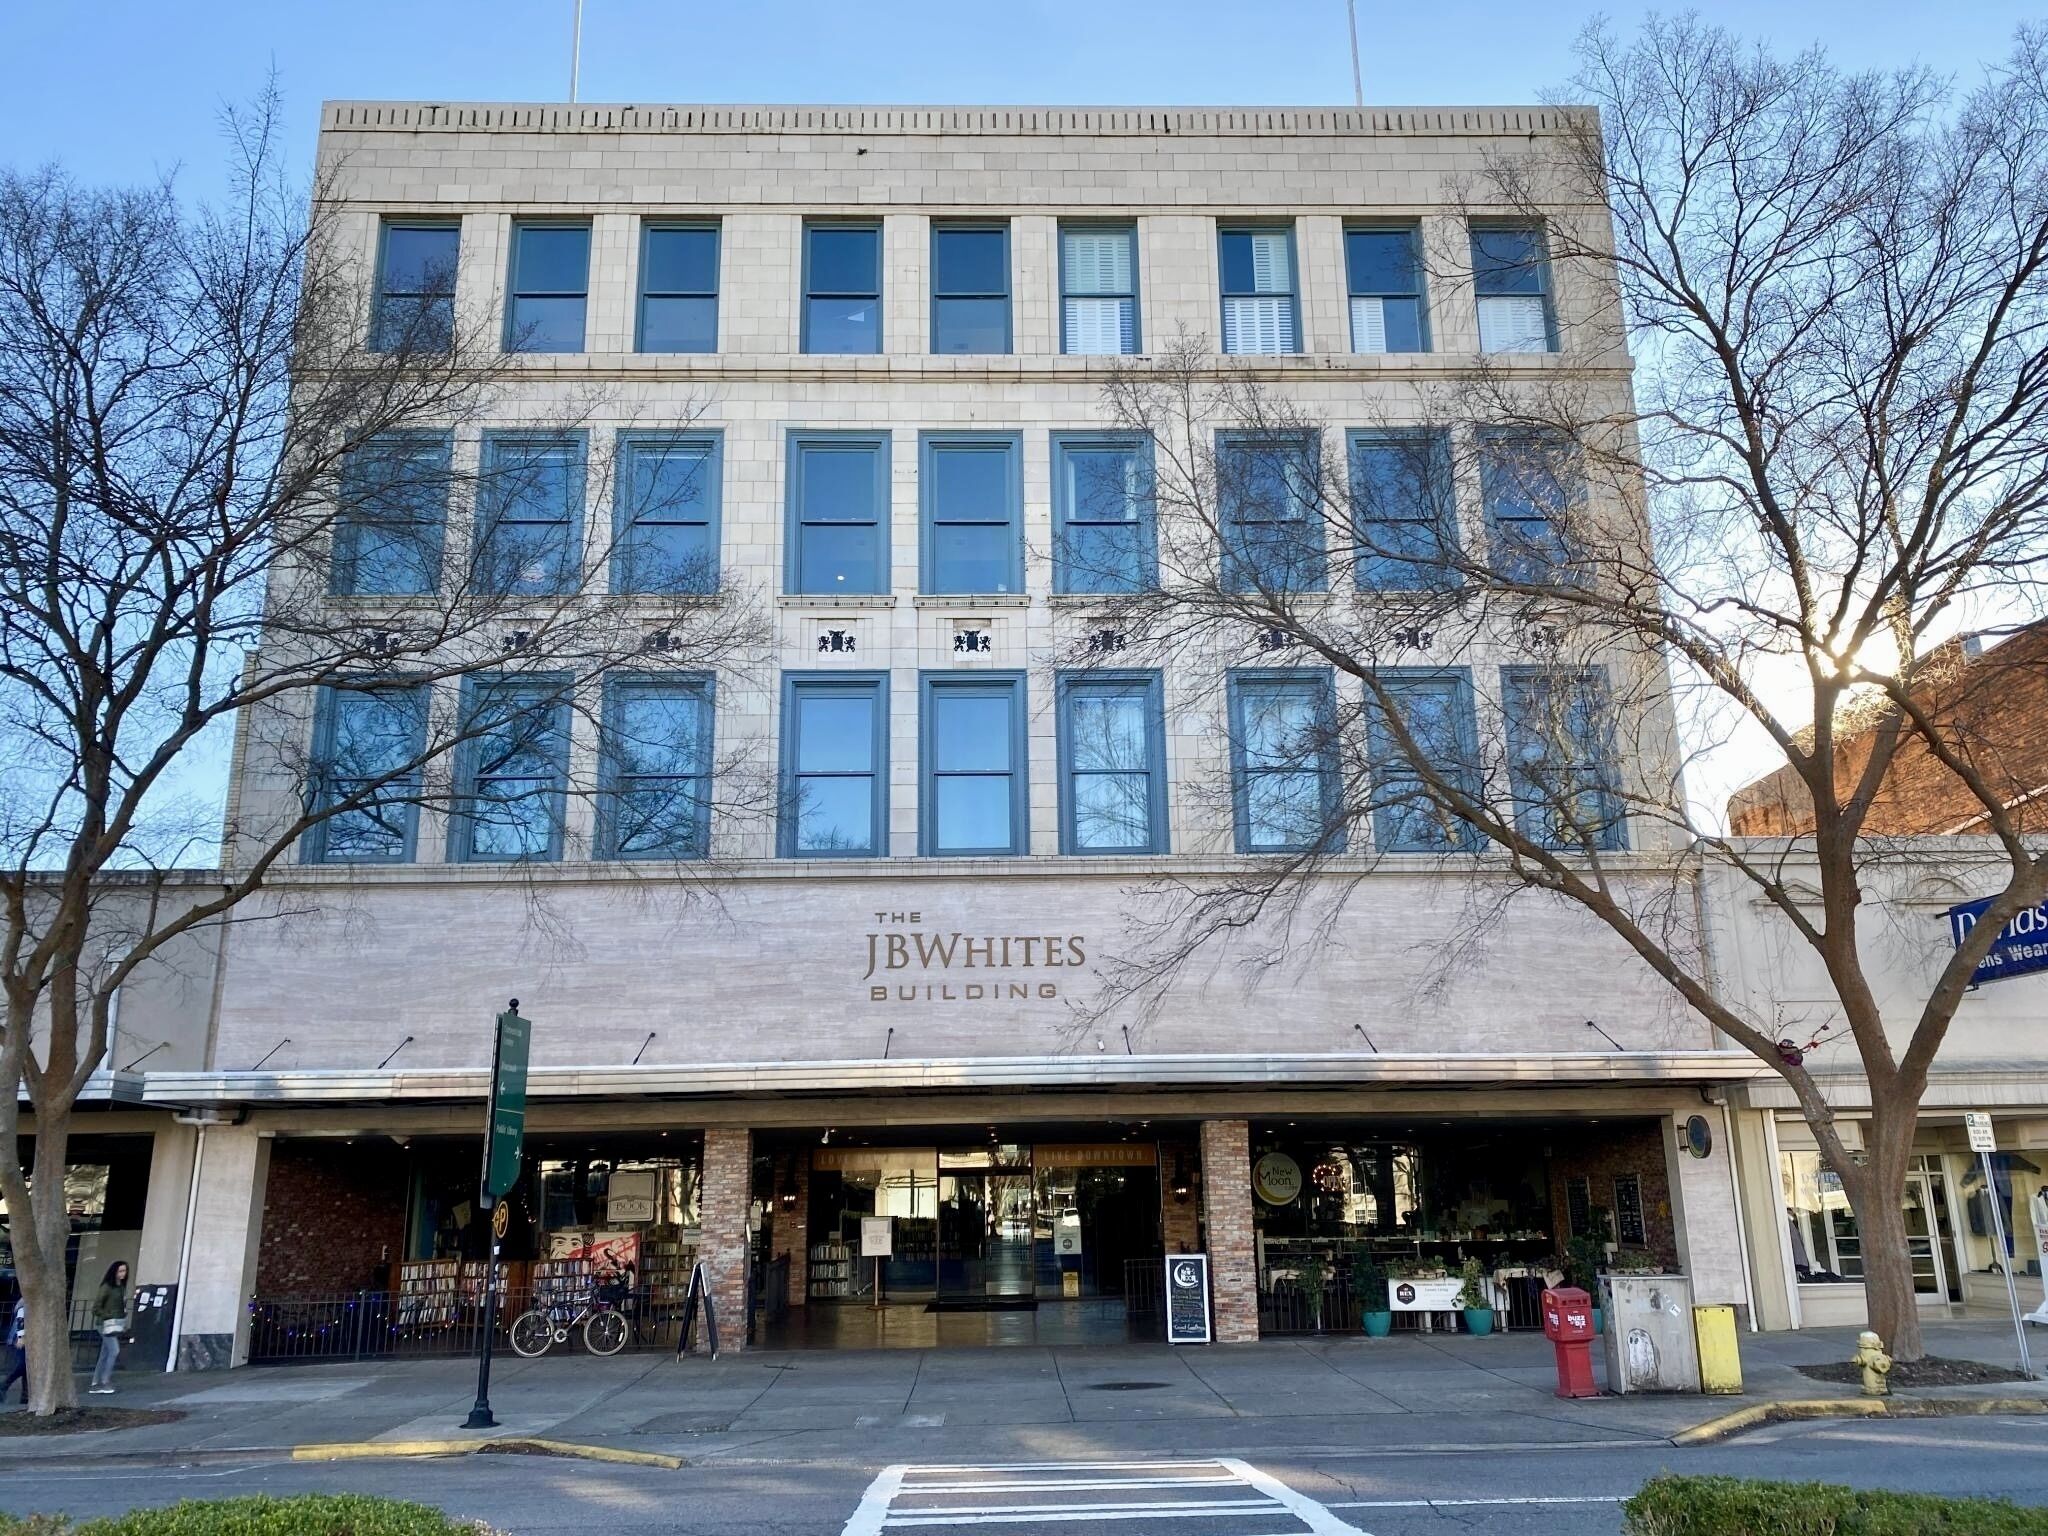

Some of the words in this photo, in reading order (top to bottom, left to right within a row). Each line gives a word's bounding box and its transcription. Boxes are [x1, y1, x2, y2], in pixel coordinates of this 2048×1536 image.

[875, 912, 922, 924] THE
[2008, 943, 2048, 961] Wear
[870, 983, 1057, 1001] BUILDING
[1967, 1115, 1974, 1125] 2
[1044, 1150, 1071, 1161] LIVE
[1272, 1166, 1293, 1176] New
[1259, 1170, 1292, 1186] Moon
[1567, 1314, 1586, 1322] buzz
